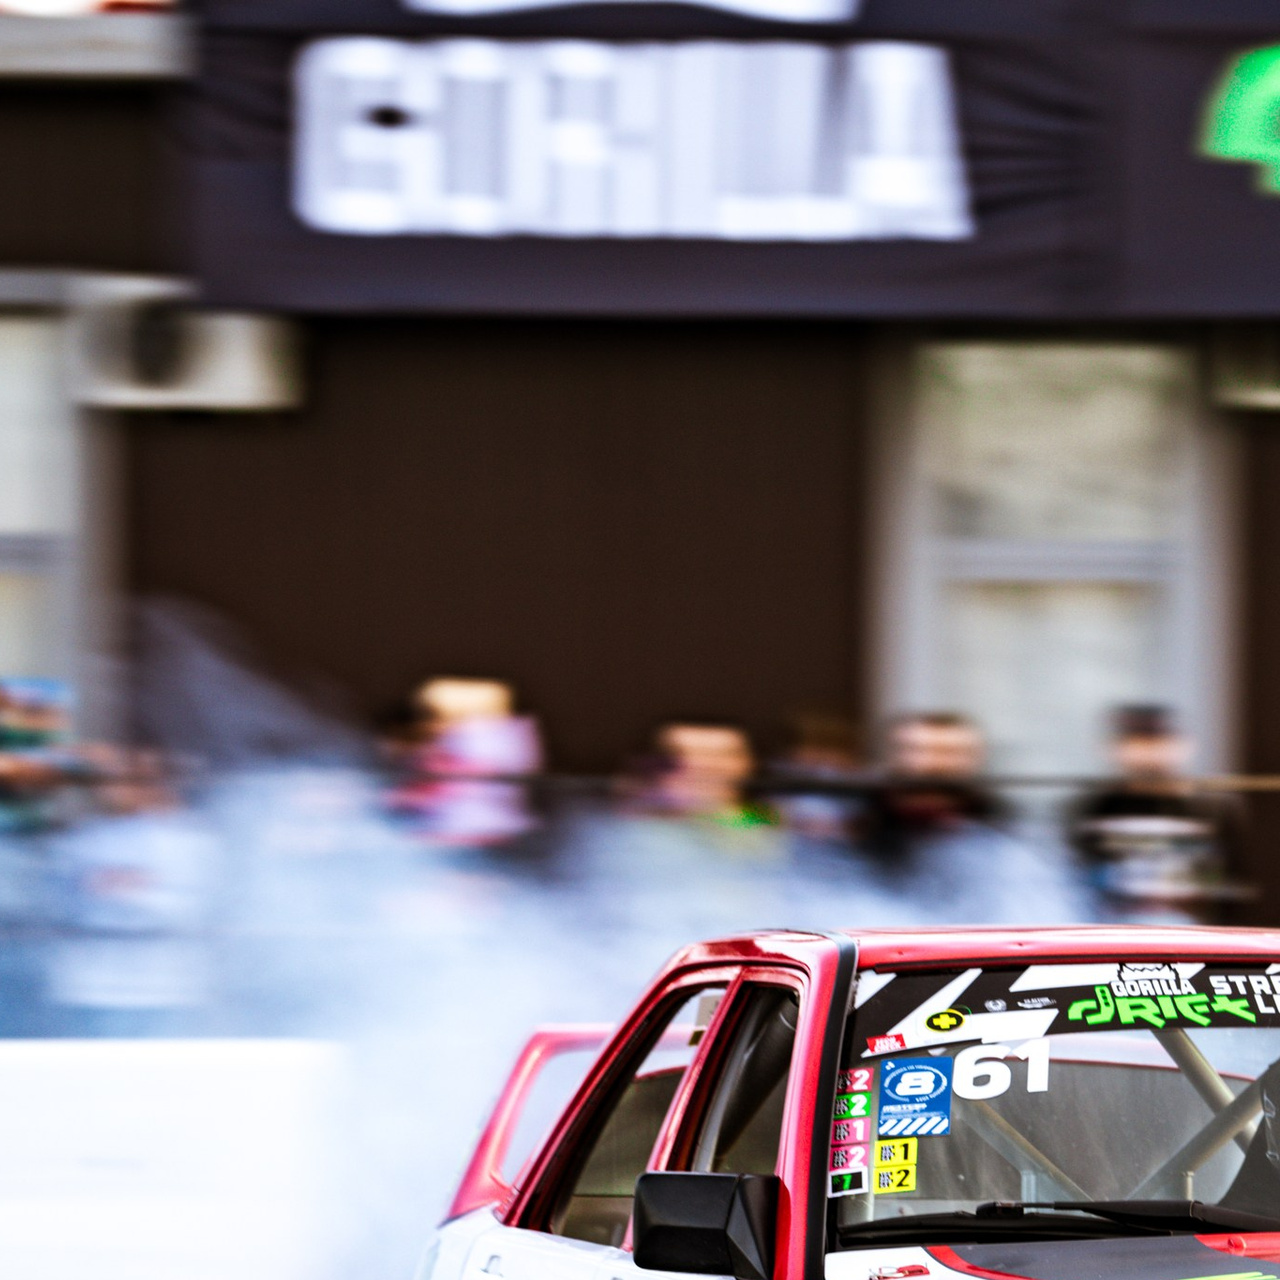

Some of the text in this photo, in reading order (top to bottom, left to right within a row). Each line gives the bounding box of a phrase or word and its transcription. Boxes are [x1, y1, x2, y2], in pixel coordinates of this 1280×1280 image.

[1110, 978, 1198, 997] GORILLA
[952, 1037, 1050, 1100] 61
[852, 1069, 870, 1091] 2
[850, 1094, 868, 1117] 2
[852, 1119, 865, 1141] 1
[848, 1145, 866, 1168] 2
[900, 1143, 909, 1161] 1
[896, 1169, 910, 1188] 2
